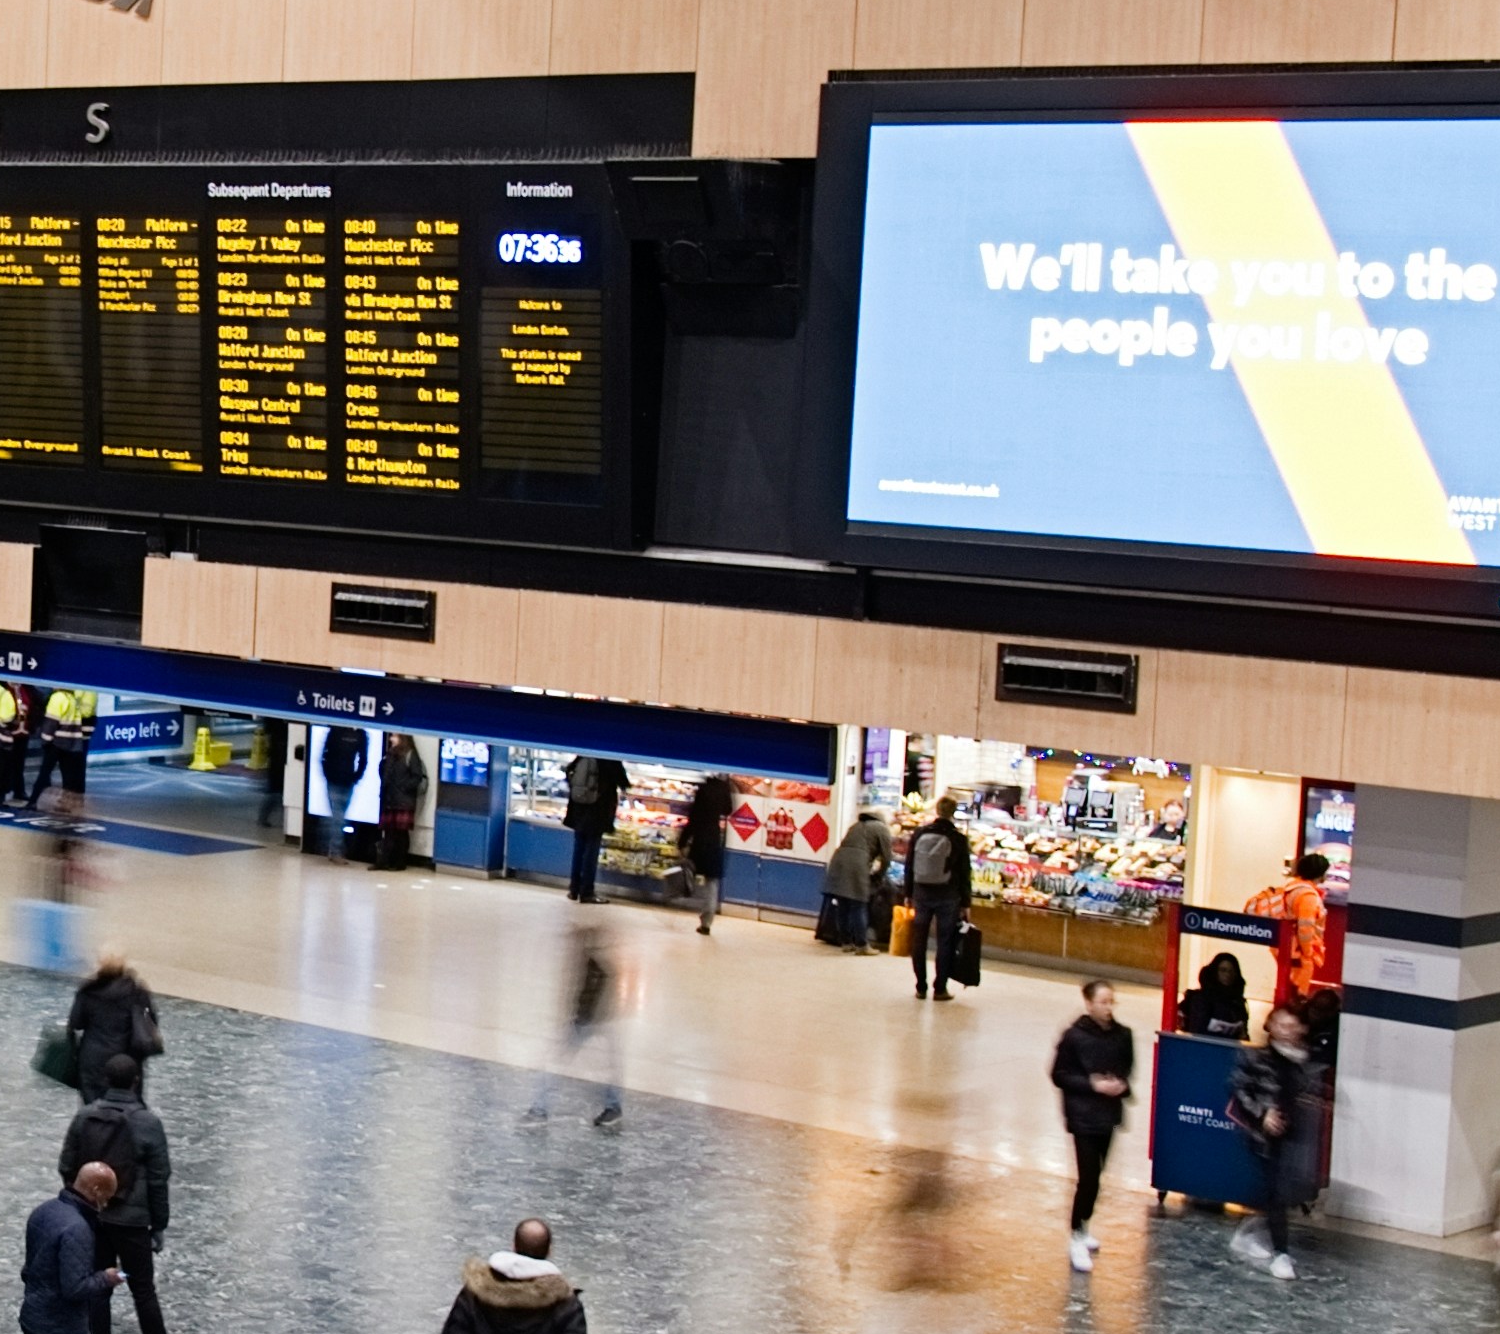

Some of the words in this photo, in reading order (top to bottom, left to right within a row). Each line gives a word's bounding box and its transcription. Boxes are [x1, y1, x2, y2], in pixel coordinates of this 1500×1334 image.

[208, 183, 269, 200] Subsequent
[271, 184, 331, 200] Departures
[506, 181, 573, 198] Information
[31, 217, 70, 229] Platform
[146, 218, 188, 232] Platform
[217, 219, 247, 233] 08:22
[286, 220, 299, 233] On
[303, 220, 325, 234] time
[345, 220, 376, 234] 08:40
[417, 221, 431, 234] On
[435, 221, 459, 235] time
[260, 237, 266, 250] T
[271, 238, 301, 252] Valley
[345, 239, 407, 252] Manchester
[411, 239, 433, 253] Picc
[375, 256, 394, 265] West
[396, 256, 420, 265] Coast
[218, 273, 247, 286] 08:23
[286, 274, 300, 287] On
[303, 274, 325, 288] time
[980, 243, 1100, 294] We'll
[1112, 247, 1205, 296] take
[1232, 253, 1325, 304] you
[1339, 250, 1395, 299] to
[1404, 248, 1497, 302] the
[345, 276, 376, 289] 08:43
[417, 277, 431, 290] On
[436, 277, 459, 290] time
[218, 290, 272, 305] Birmingham
[275, 292, 295, 305] New
[299, 293, 311, 305] St
[345, 295, 361, 307] via
[364, 295, 414, 310] Birmingham
[417, 296, 436, 308] New
[439, 296, 452, 309] St
[345, 331, 376, 344] 08:45
[1029, 306, 1198, 366] people
[1209, 317, 1303, 370] you
[1314, 312, 1429, 365] love
[219, 343, 259, 357] Watford
[262, 345, 305, 359] Junction
[346, 348, 388, 362] Watford
[392, 349, 436, 364] Junction
[220, 379, 248, 392] 08:30
[220, 396, 258, 411] Glasgow
[262, 398, 300, 413] Central
[346, 402, 379, 417] Crewe
[220, 432, 249, 445] 08:34
[221, 449, 248, 464] Tring
[418, 443, 432, 456] On
[436, 443, 459, 458] time
[358, 458, 426, 475] Northampton
[312, 693, 355, 712] Toilets
[105, 724, 136, 742] Keep
[139, 720, 160, 738] left
[1202, 917, 1272, 939] Information
[1178, 1105, 1213, 1118] AVANTI
[1178, 1114, 1203, 1124] WEST
